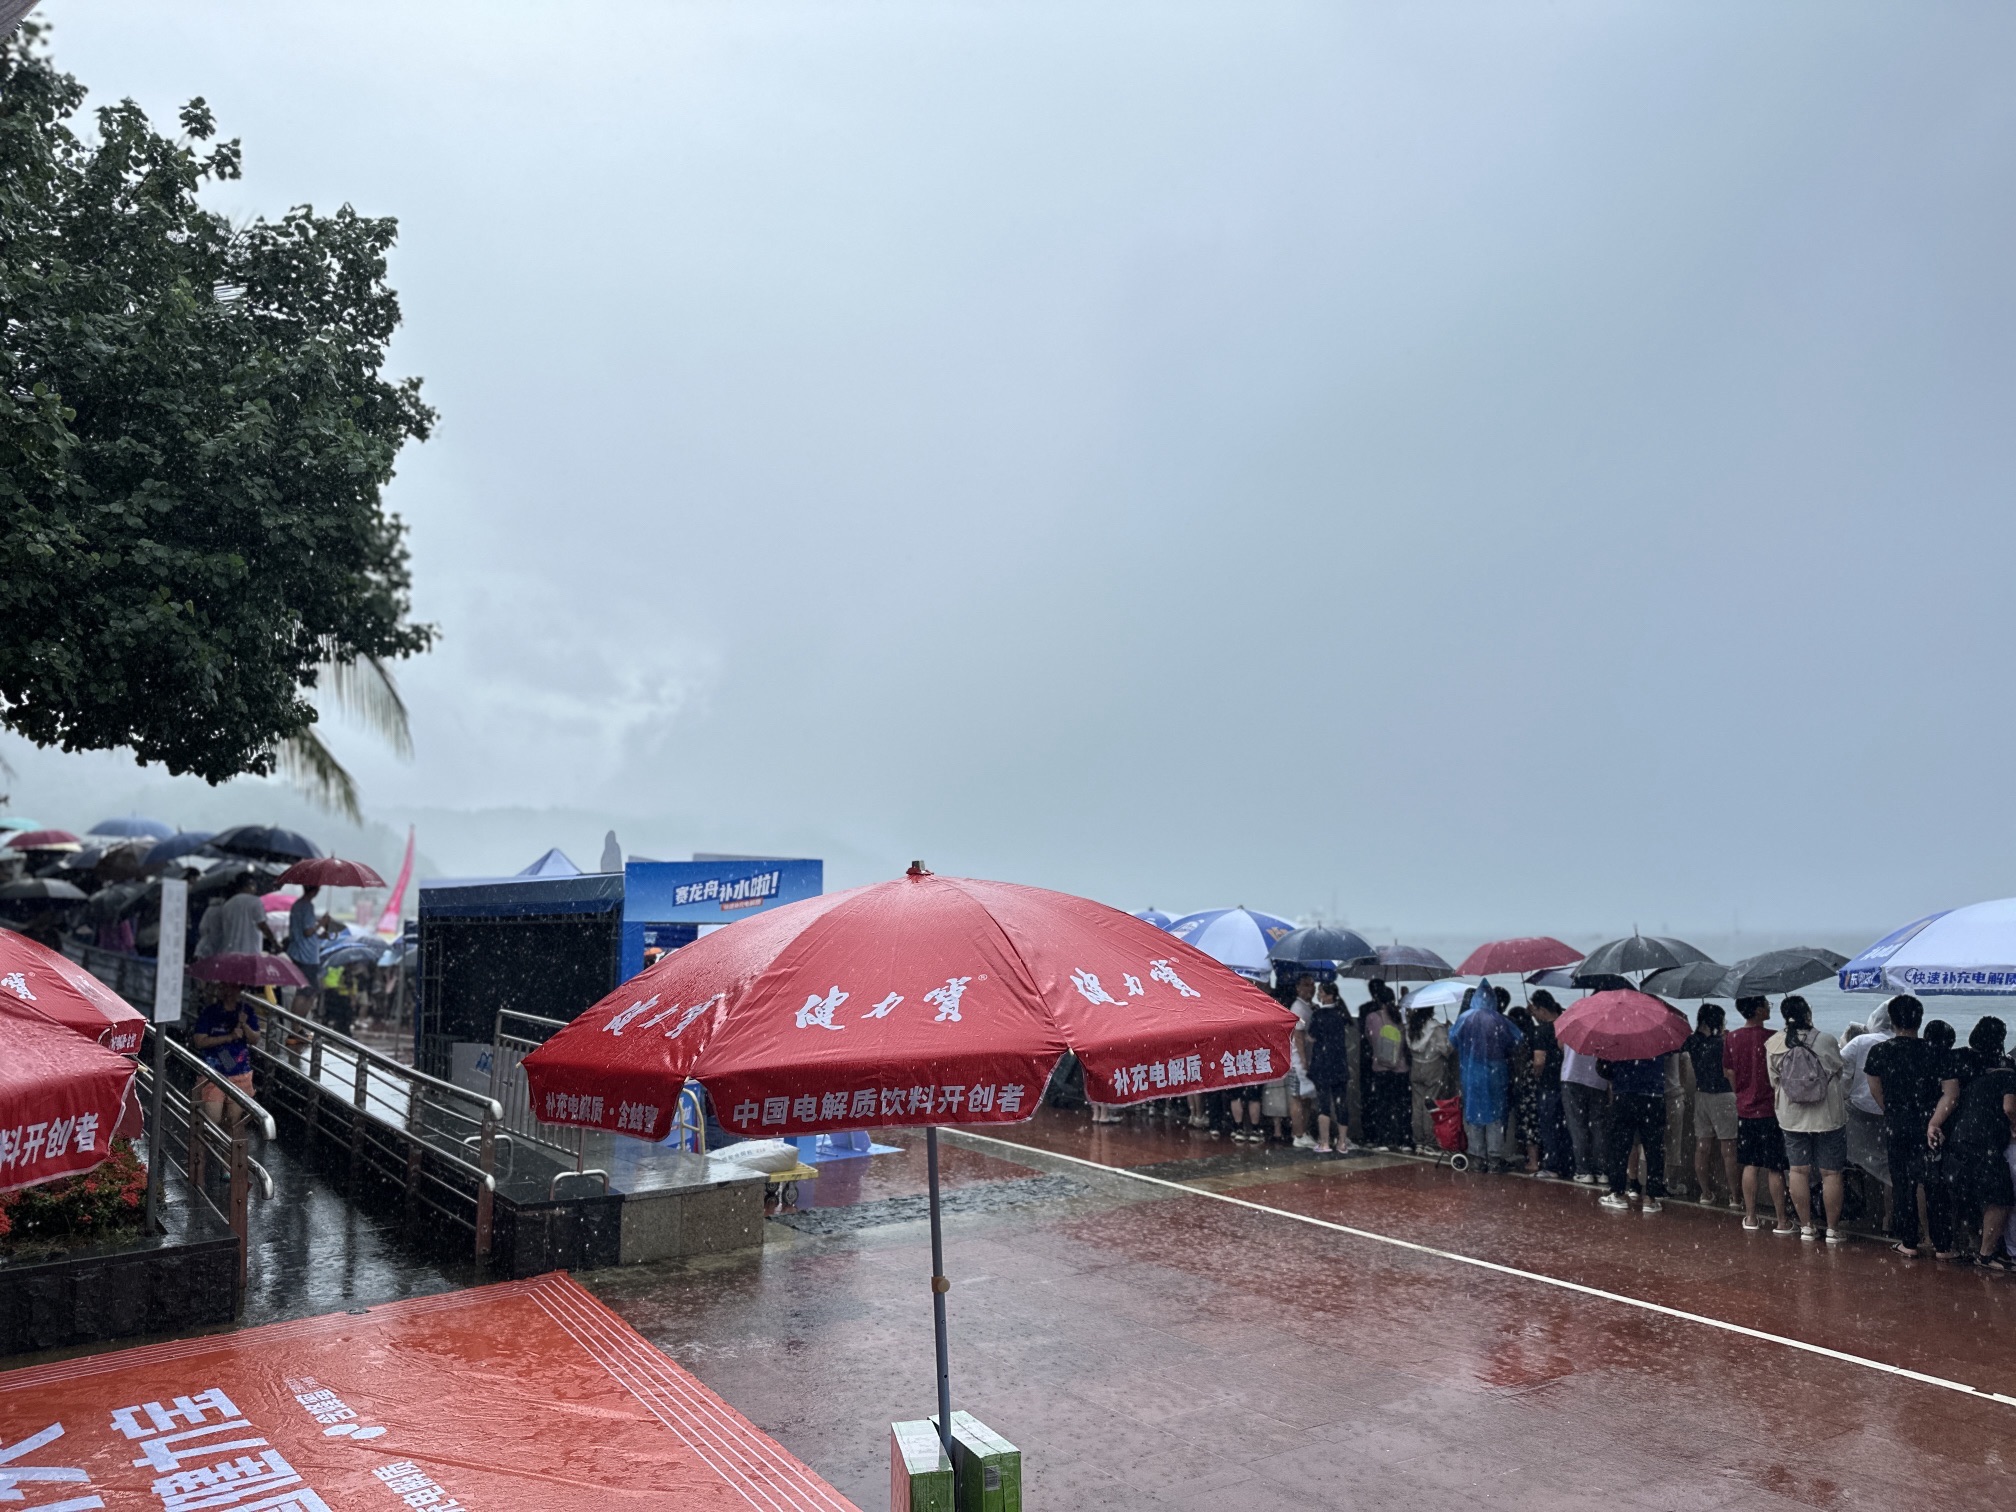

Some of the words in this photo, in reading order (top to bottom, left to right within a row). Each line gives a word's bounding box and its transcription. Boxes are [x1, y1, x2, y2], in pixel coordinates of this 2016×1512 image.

[675, 871, 779, 905] 赛龙舟补水啦!
[732, 1083, 1025, 1129] 中国电解质饮料开创者
